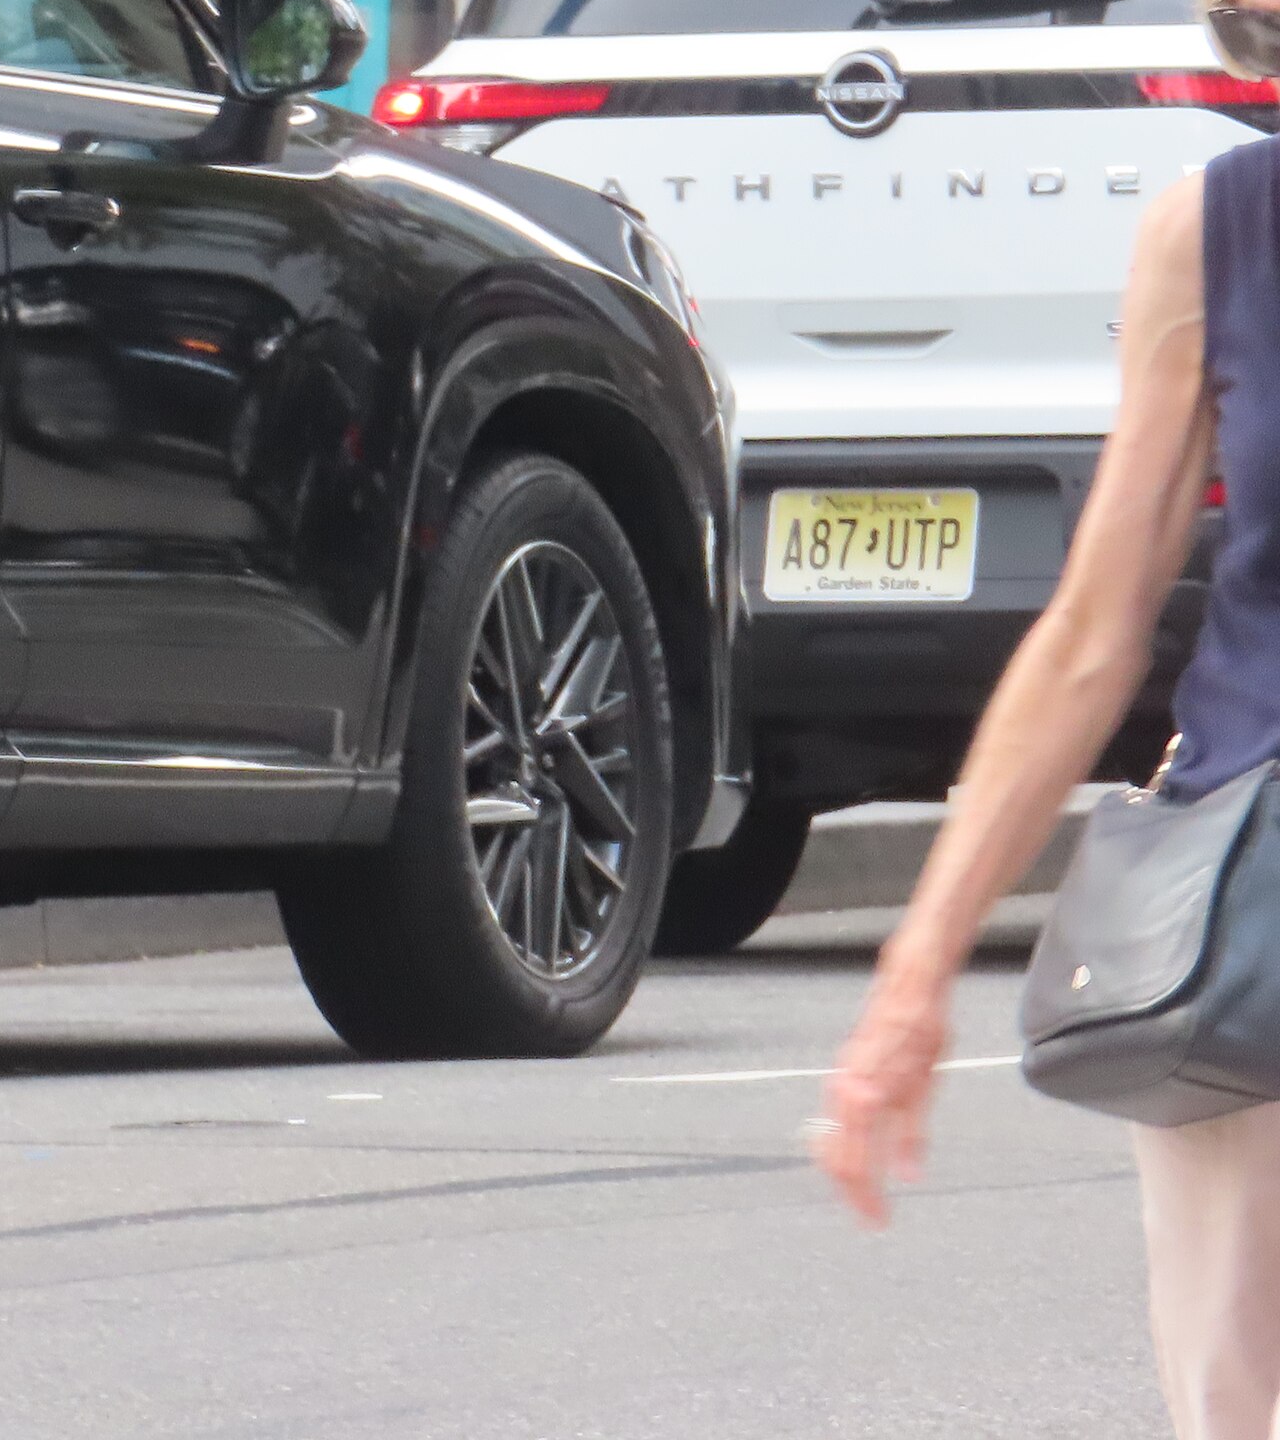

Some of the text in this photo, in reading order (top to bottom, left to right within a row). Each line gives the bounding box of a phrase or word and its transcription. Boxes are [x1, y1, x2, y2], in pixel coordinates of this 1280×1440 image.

[816, 87, 905, 102] NISSAN
[601, 164, 1206, 203] ATHFINDE
[817, 576, 921, 591] Garden State
